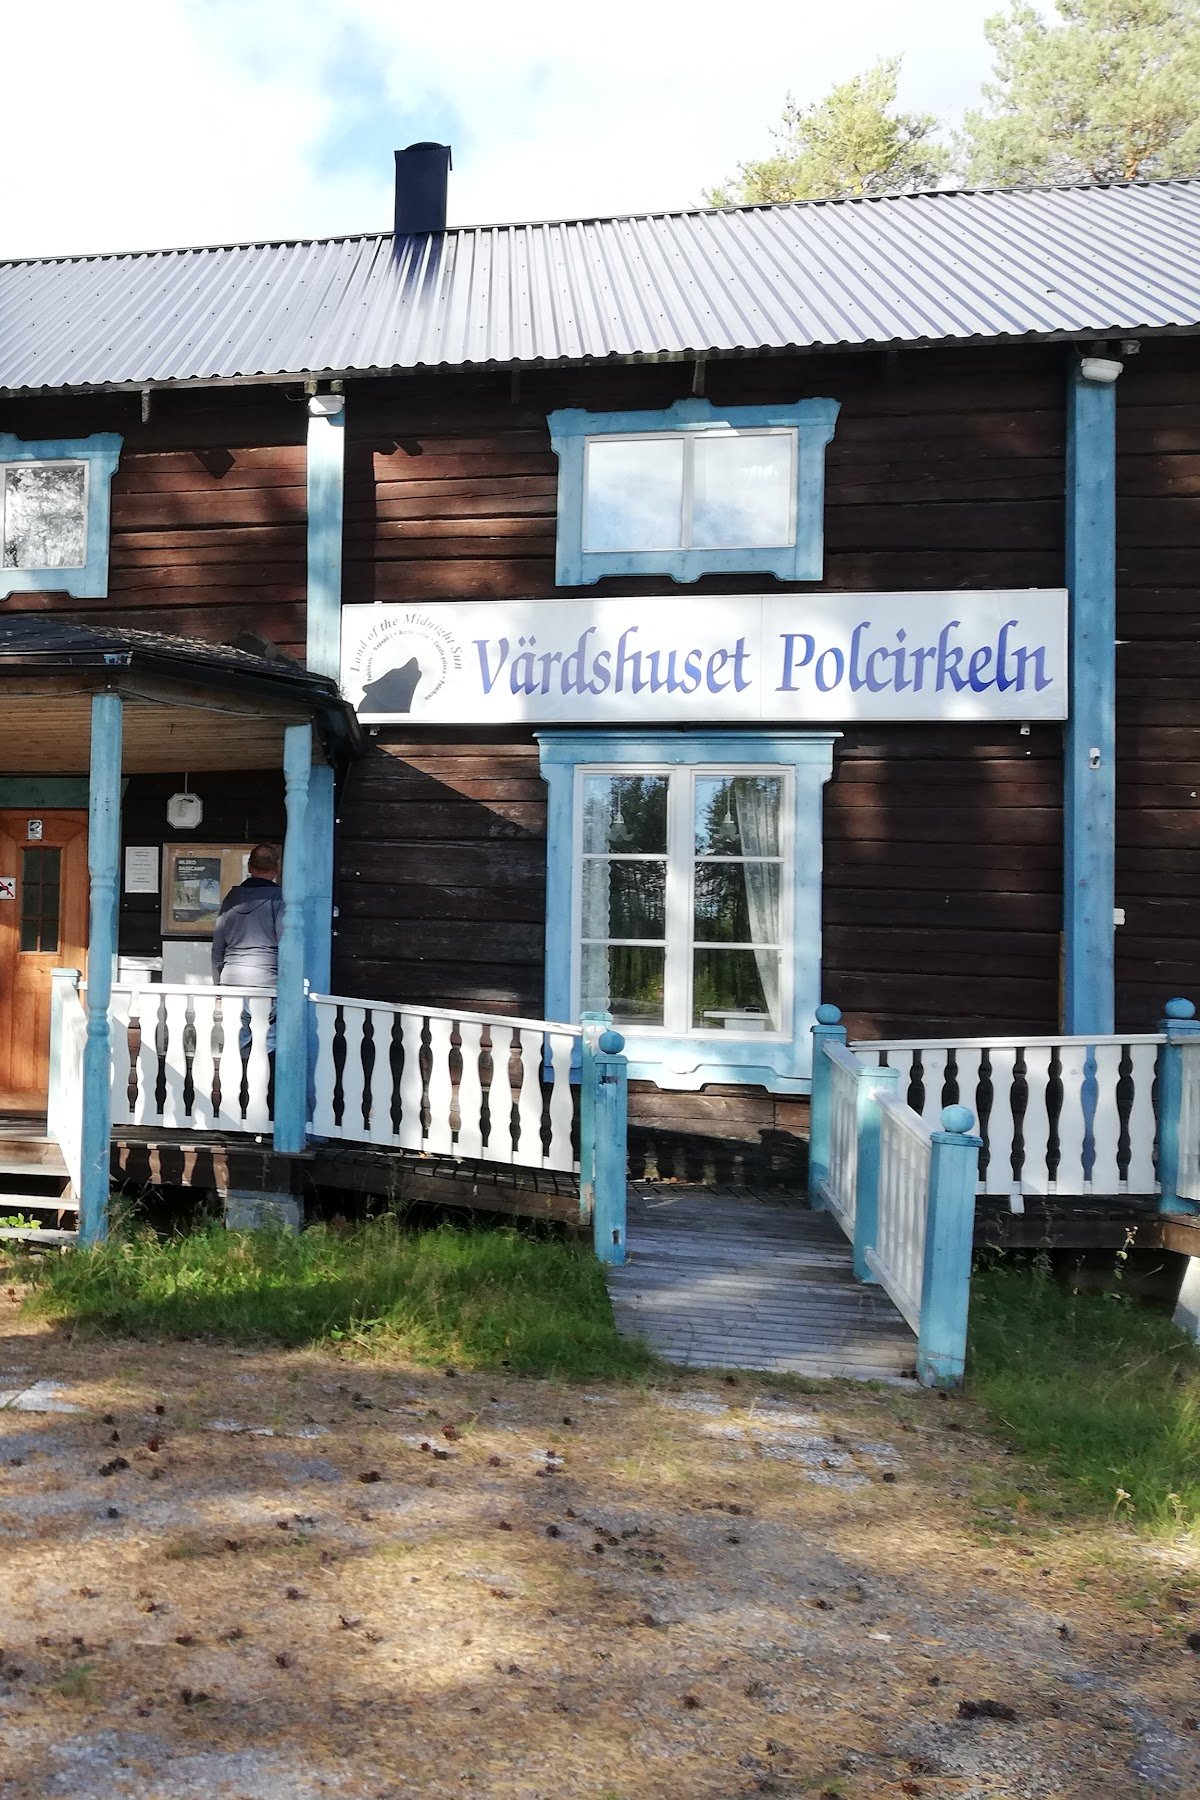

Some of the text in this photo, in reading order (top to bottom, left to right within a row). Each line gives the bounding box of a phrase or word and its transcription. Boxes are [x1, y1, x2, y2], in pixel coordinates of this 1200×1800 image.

[350, 640, 368, 672] Land
[368, 625, 378, 641] of
[380, 618, 398, 631] the
[403, 613, 456, 645] Midnight
[450, 646, 463, 670] Sun
[471, 620, 1054, 696] Värdshuset Polcirkeln
